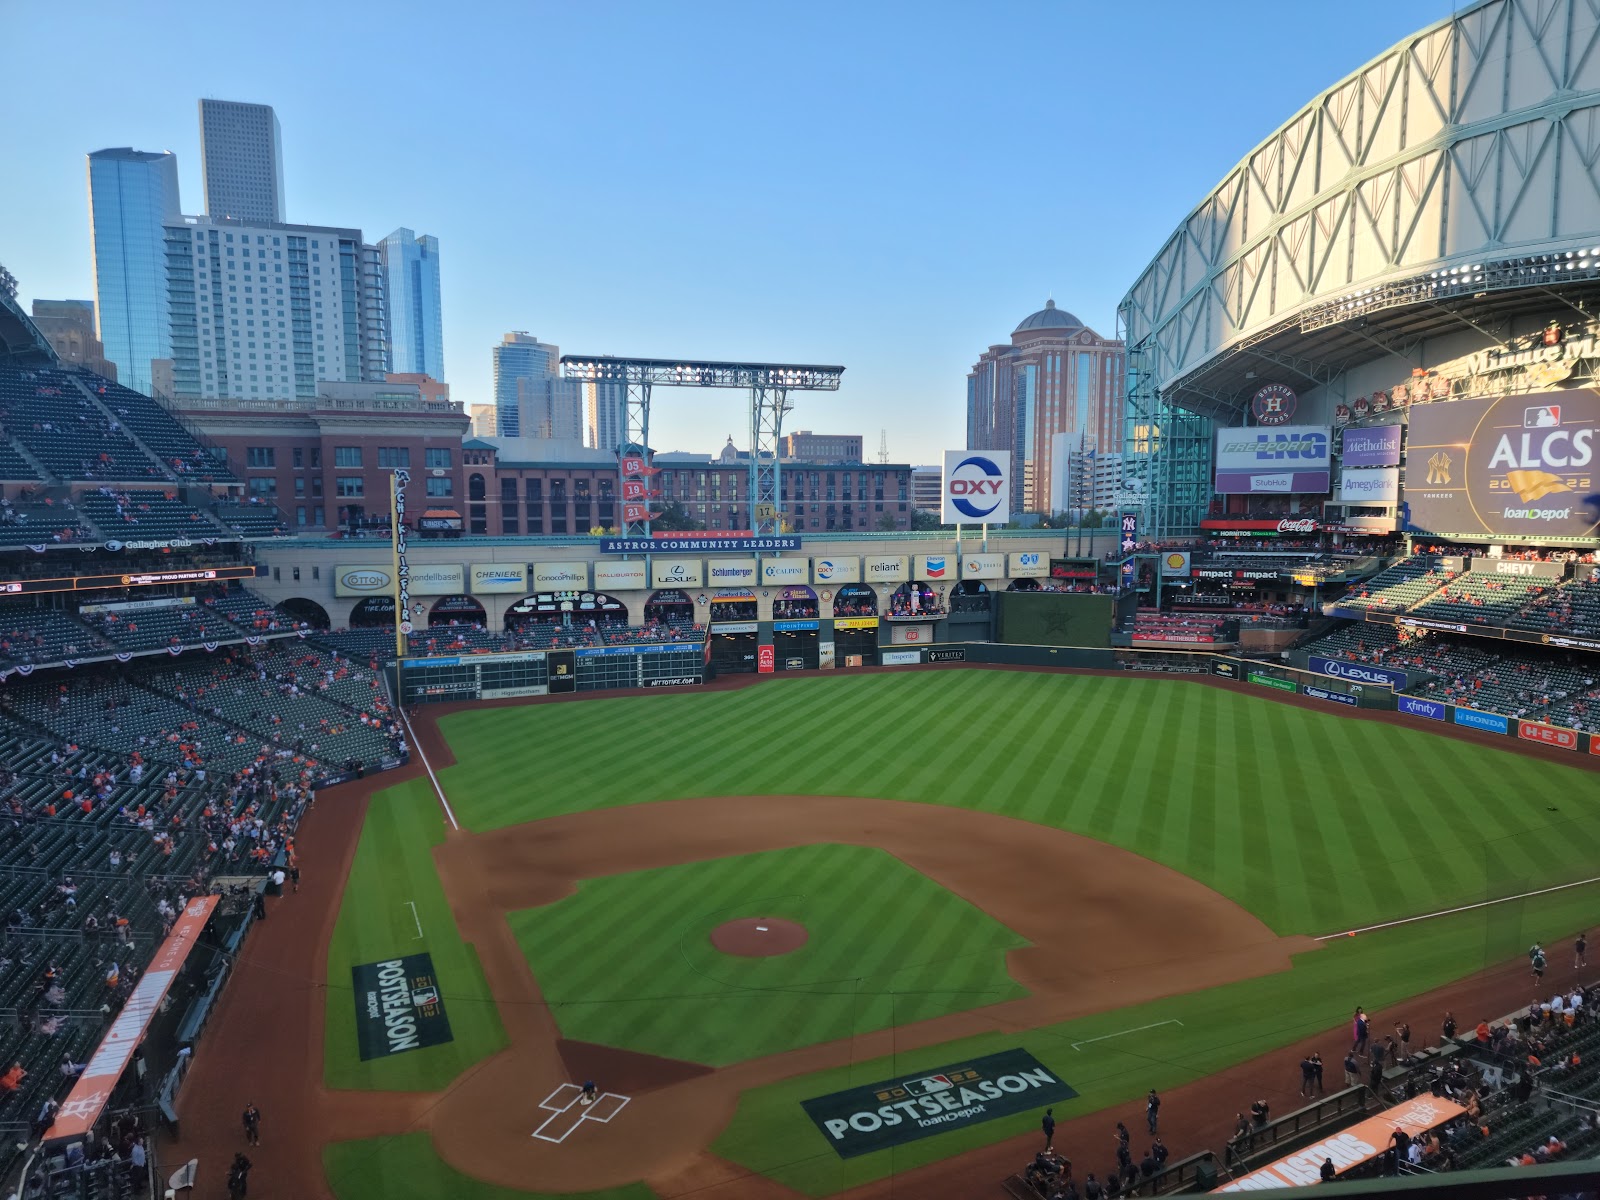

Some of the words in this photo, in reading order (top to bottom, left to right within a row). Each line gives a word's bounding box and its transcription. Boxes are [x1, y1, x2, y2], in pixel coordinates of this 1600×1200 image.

[1258, 385, 1292, 398] HOUSTON
[1265, 398, 1283, 412] H
[1258, 412, 1289, 424] ASTROS
[1225, 440, 1315, 453] FREEPORT
[1347, 438, 1397, 453] Methodist
[1487, 428, 1594, 469] ALCS
[626, 461, 639, 471] 05
[949, 479, 1004, 495] OXY
[1255, 478, 1288, 487] StubHub
[627, 485, 640, 495] 19
[627, 507, 640, 517] 21
[759, 507, 770, 517] 17
[1502, 506, 1571, 522] loanDepot
[395, 493, 407, 554] CHIKIN
[125, 540, 168, 549] Gallagher
[170, 538, 192, 547] Club
[660, 540, 739, 549] COMMUNITY
[743, 539, 795, 548] LEADERS
[711, 568, 753, 578] Schlumberger
[775, 567, 805, 575] CALPINE
[870, 562, 901, 572] reliant
[1496, 561, 1536, 575] CHEVY
[347, 575, 383, 586] COTTON
[409, 572, 461, 582] yondellbasell
[475, 570, 523, 579] CHENIERE
[536, 573, 585, 582] ConocoPhillips
[1199, 570, 1233, 579] impact
[1243, 571, 1278, 579] impact
[398, 578, 410, 620] FAIR
[1340, 667, 1388, 684] LEXUS
[500, 688, 540, 696] Higginbotham
[1406, 699, 1437, 717] xfinity
[1465, 714, 1505, 729] HONDA
[366, 991, 381, 1019] loanDepot
[376, 959, 420, 1053] POSTSEASON
[876, 1088, 905, 1102] 20
[951, 1070, 981, 1083] 22
[823, 1067, 1057, 1140] POSTSEASON
[917, 1103, 987, 1128] loanDepot
[1271, 1133, 1378, 1187] ASTROS
